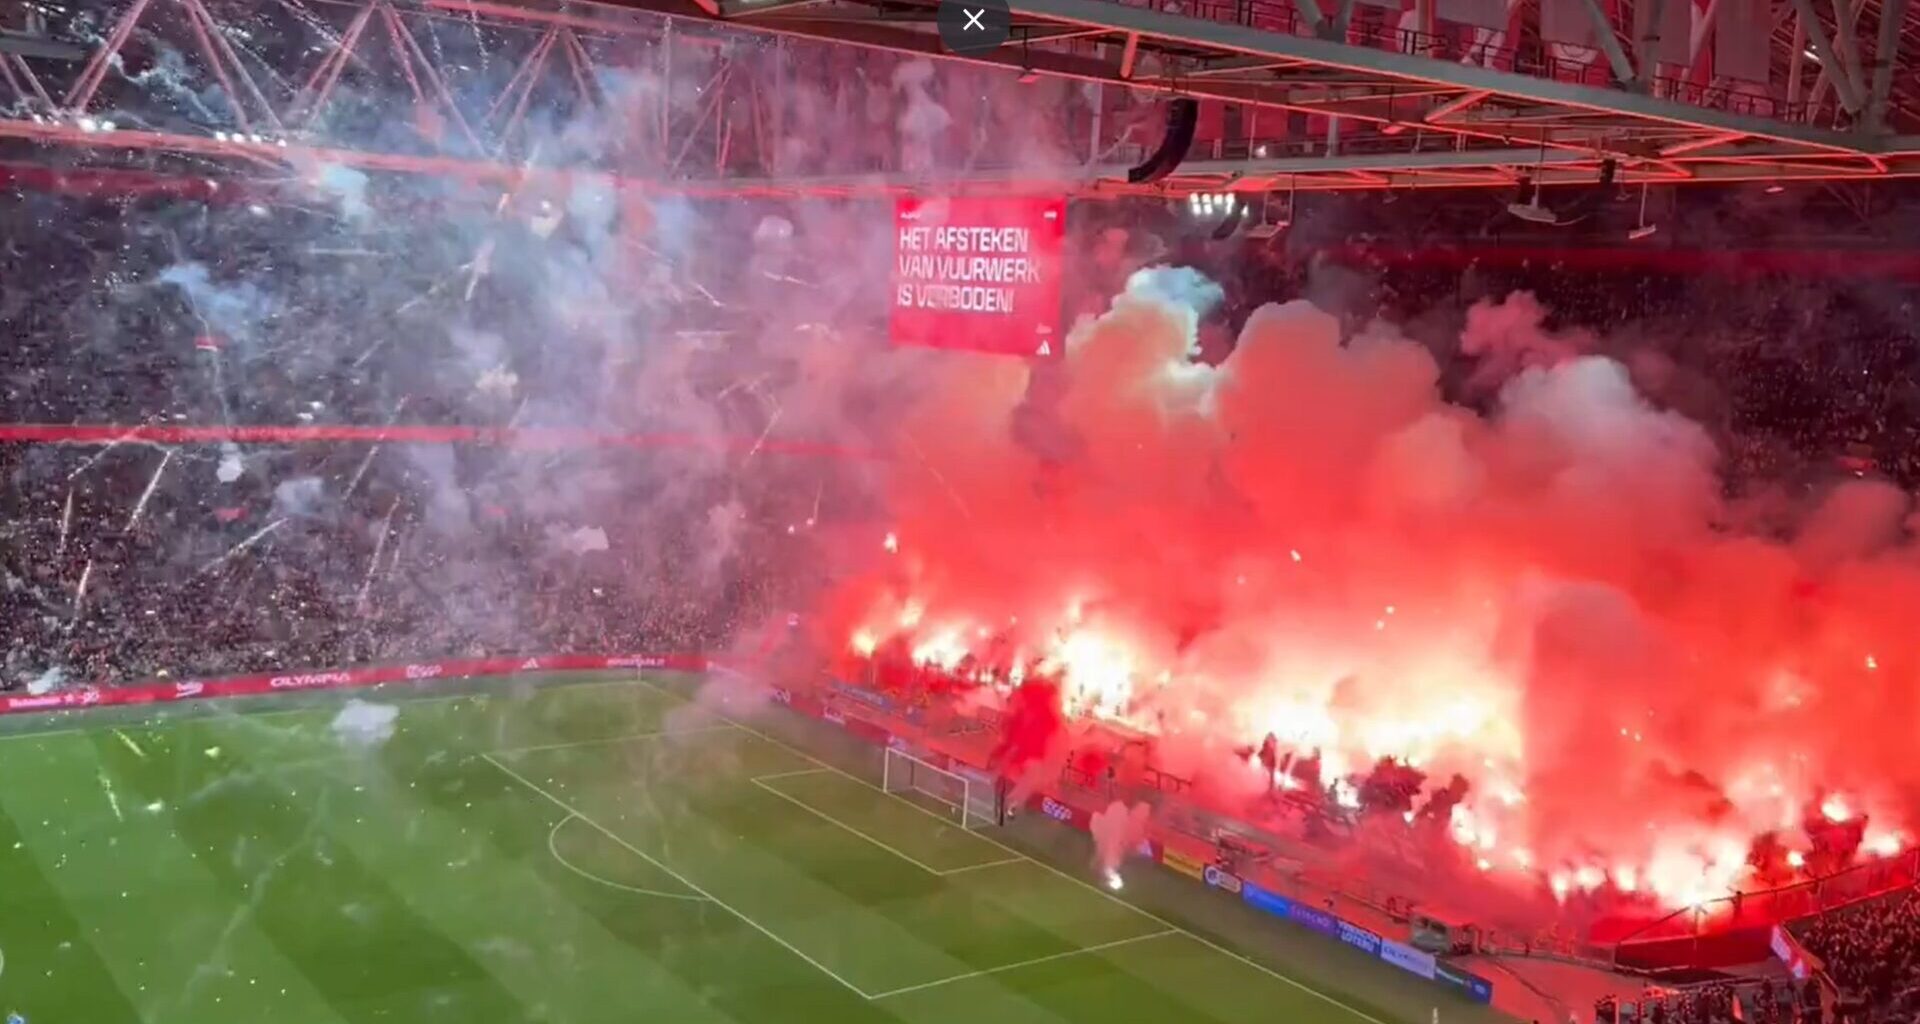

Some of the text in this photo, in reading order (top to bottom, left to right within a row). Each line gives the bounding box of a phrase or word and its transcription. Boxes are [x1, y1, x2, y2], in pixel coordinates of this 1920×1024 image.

[900, 226, 1029, 253] HET AFSTEKEN
[899, 254, 1041, 284] VAN VUURWERK
[897, 282, 913, 307] IS
[270, 672, 350, 688] OLYMPIA
